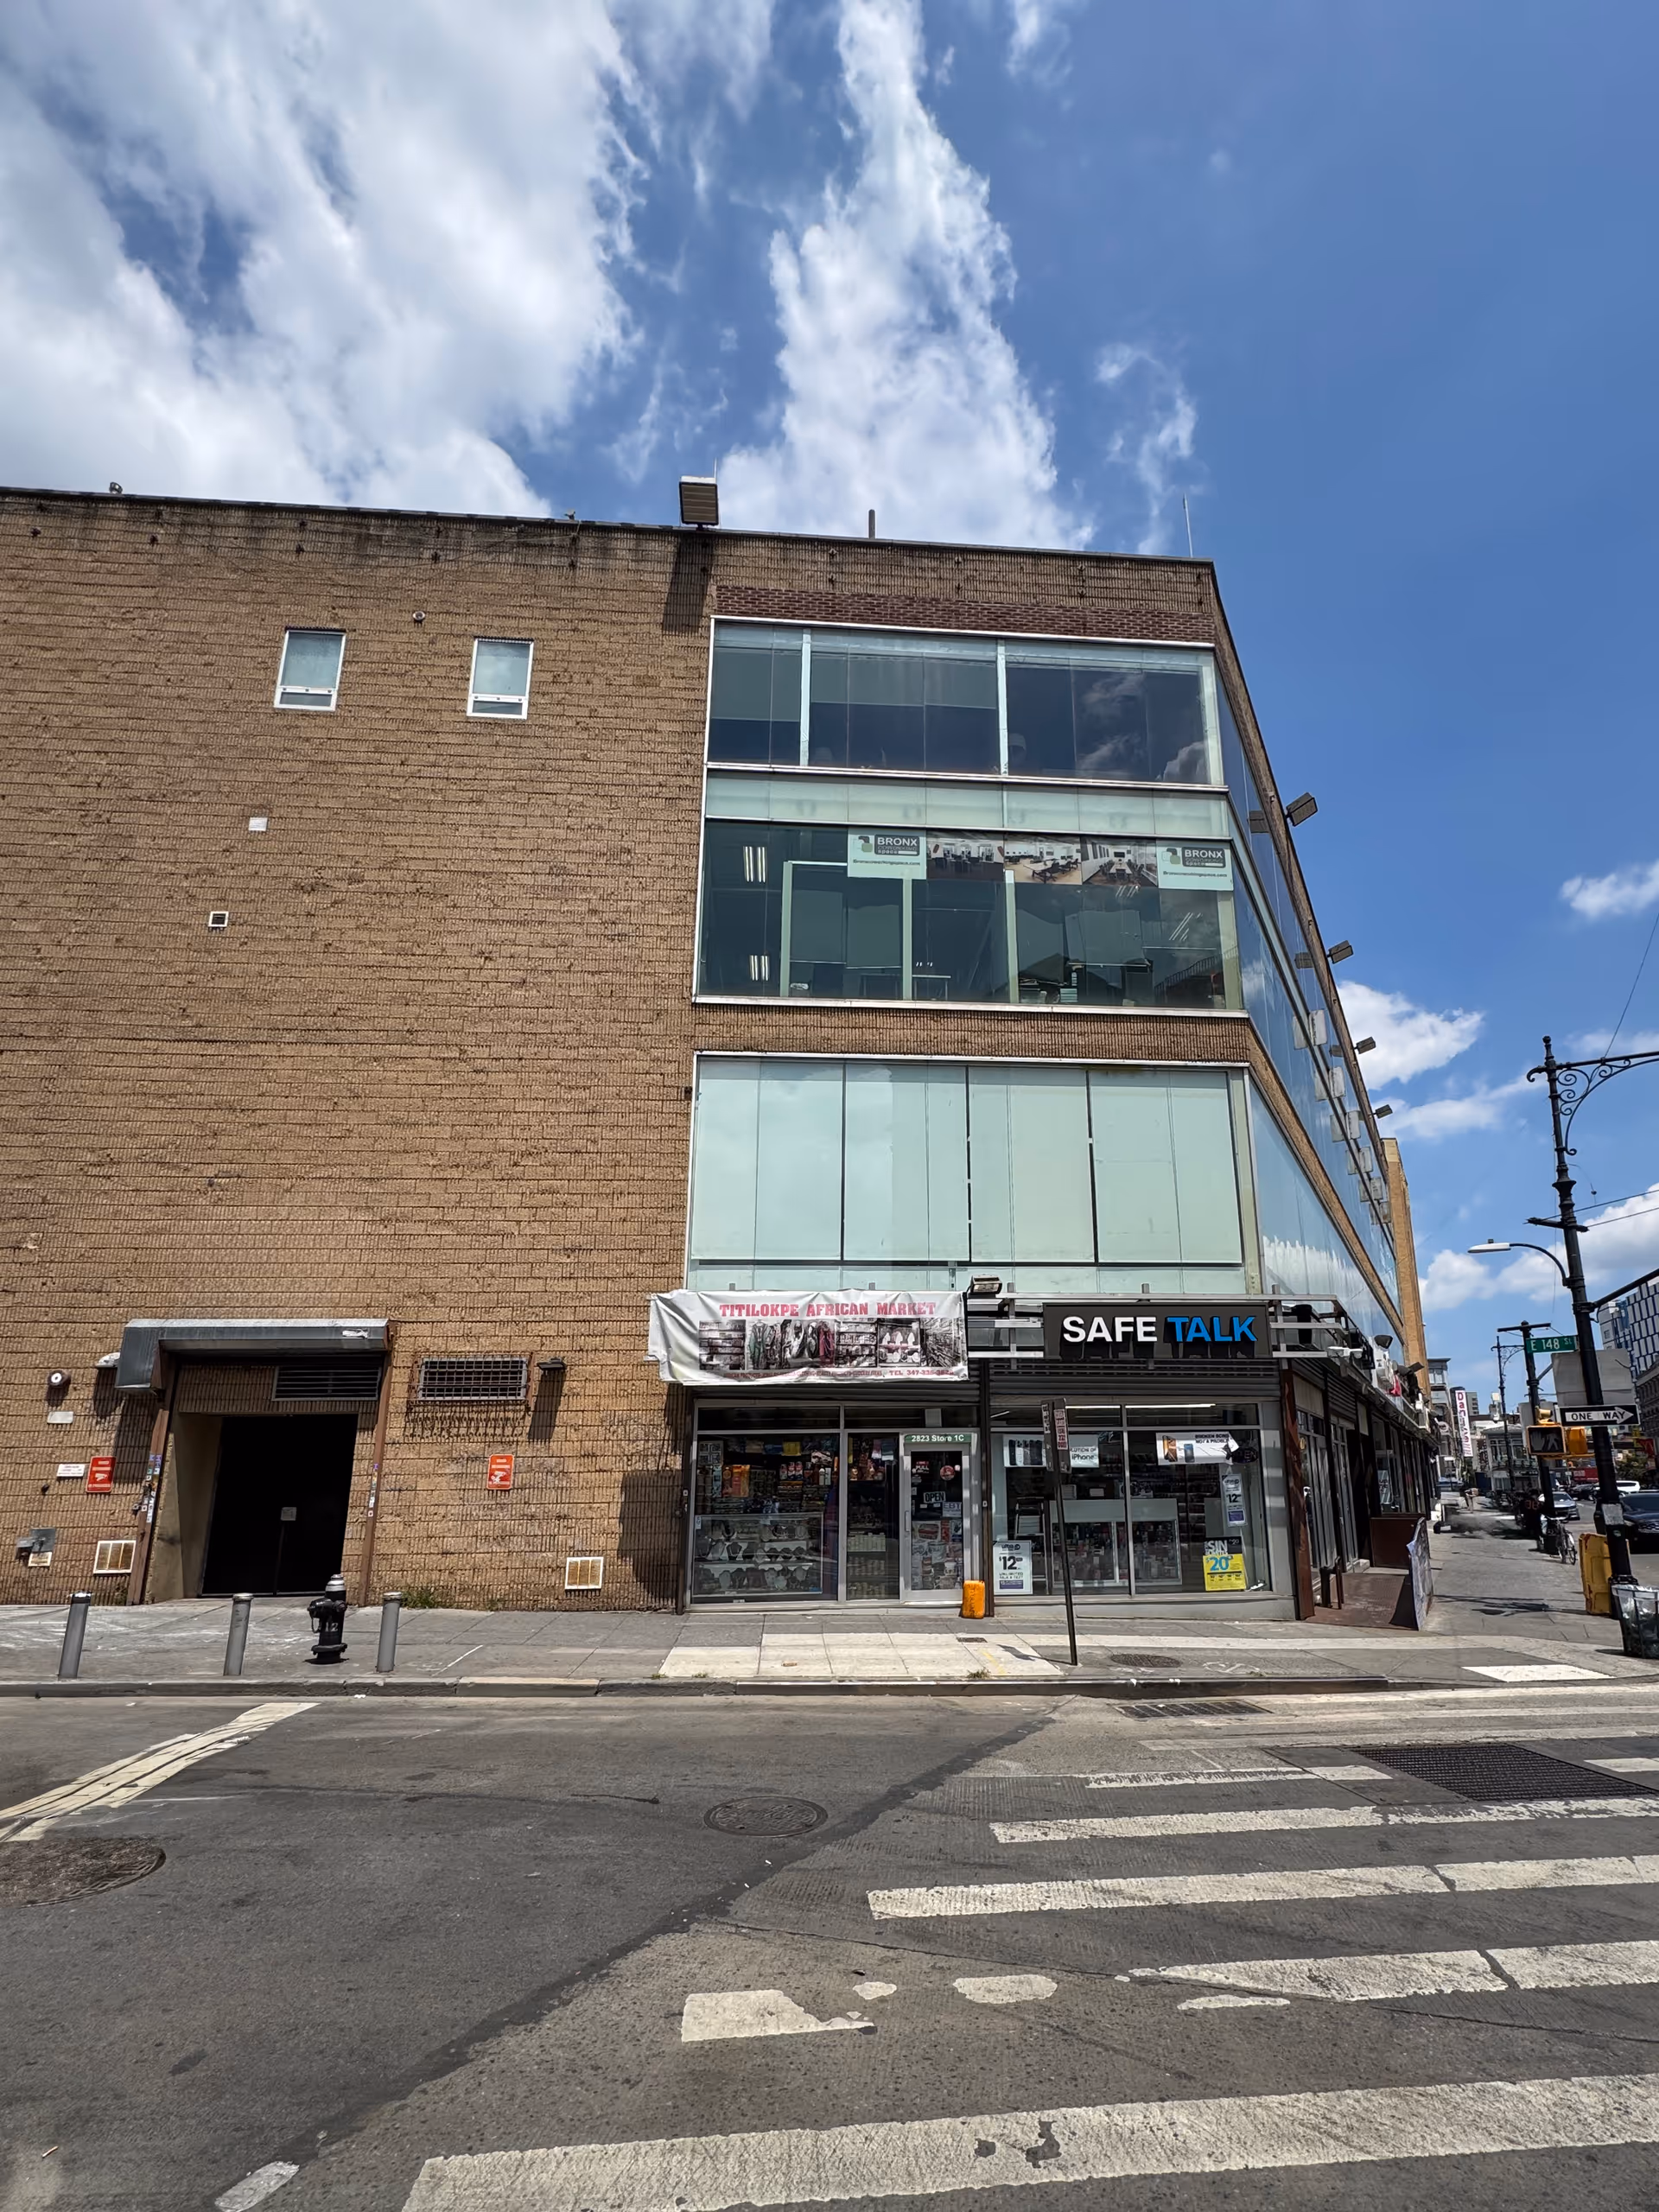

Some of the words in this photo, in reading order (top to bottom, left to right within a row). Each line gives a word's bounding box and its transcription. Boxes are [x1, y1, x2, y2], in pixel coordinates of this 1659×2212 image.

[877, 837, 918, 847] BRONX
[1185, 849, 1223, 859] BRONX
[720, 1304, 799, 1317] TITILOKPE
[806, 1303, 868, 1316] AFRICAN
[877, 1302, 936, 1315] MARKET
[1063, 1316, 1158, 1342] SAFE
[1167, 1316, 1257, 1342] TALK
[1530, 1340, 1537, 1351] E
[1542, 1338, 1560, 1350] 148
[1571, 1412, 1593, 1421] ONE
[925, 1492, 945, 1503] OPEN
[1207, 1540, 1228, 1553] SIN
